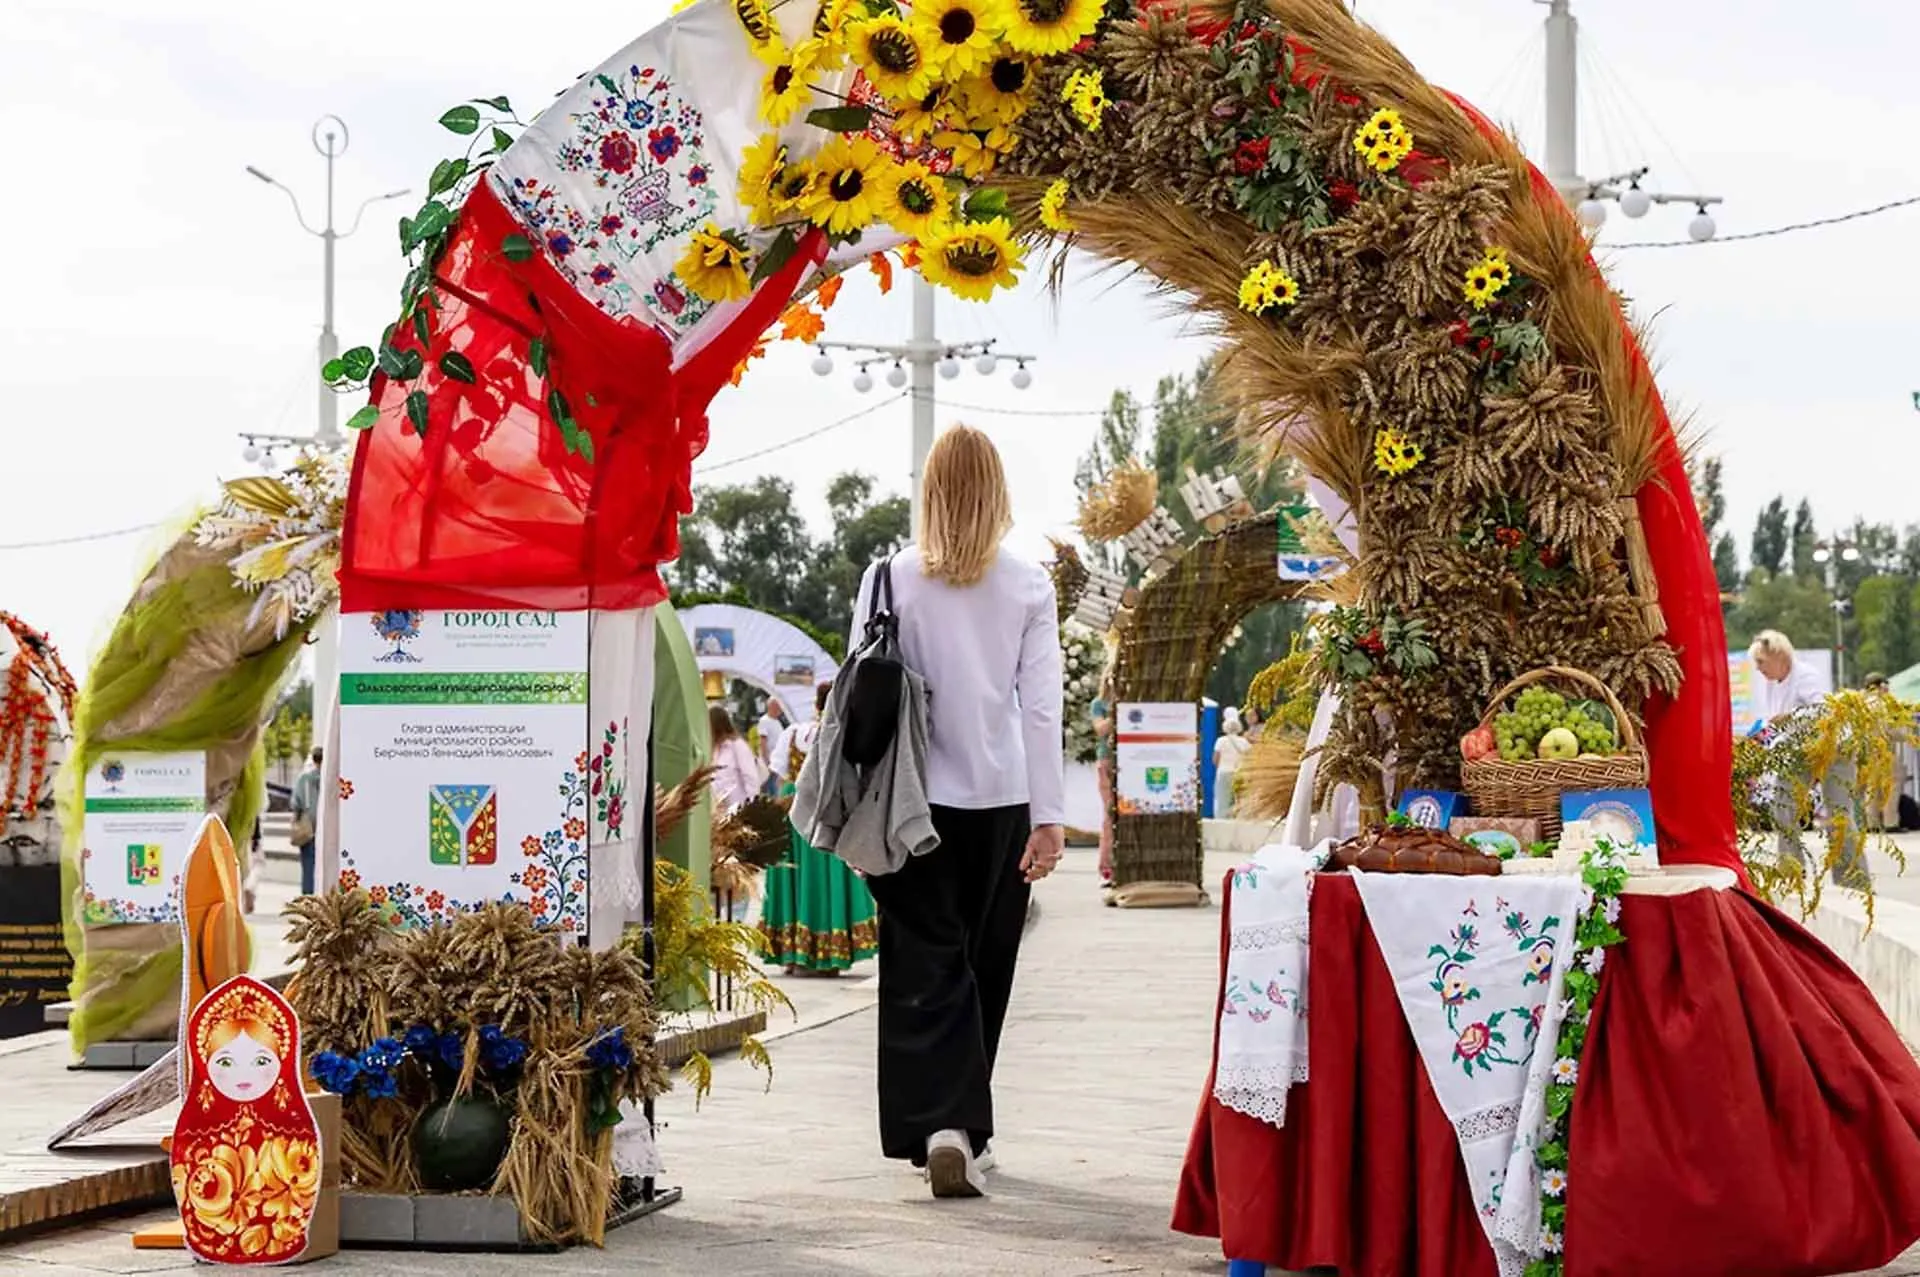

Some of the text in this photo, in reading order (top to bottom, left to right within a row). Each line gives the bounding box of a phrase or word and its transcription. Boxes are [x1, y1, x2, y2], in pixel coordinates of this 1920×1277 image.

[443, 611, 558, 628] ГОРОД САД
[534, 682, 571, 694] район
[401, 723, 526, 734] Глава администрации
[393, 735, 534, 746] муниципального района
[433, 747, 485, 758] Геннадий
[486, 747, 553, 758] Николаевич
